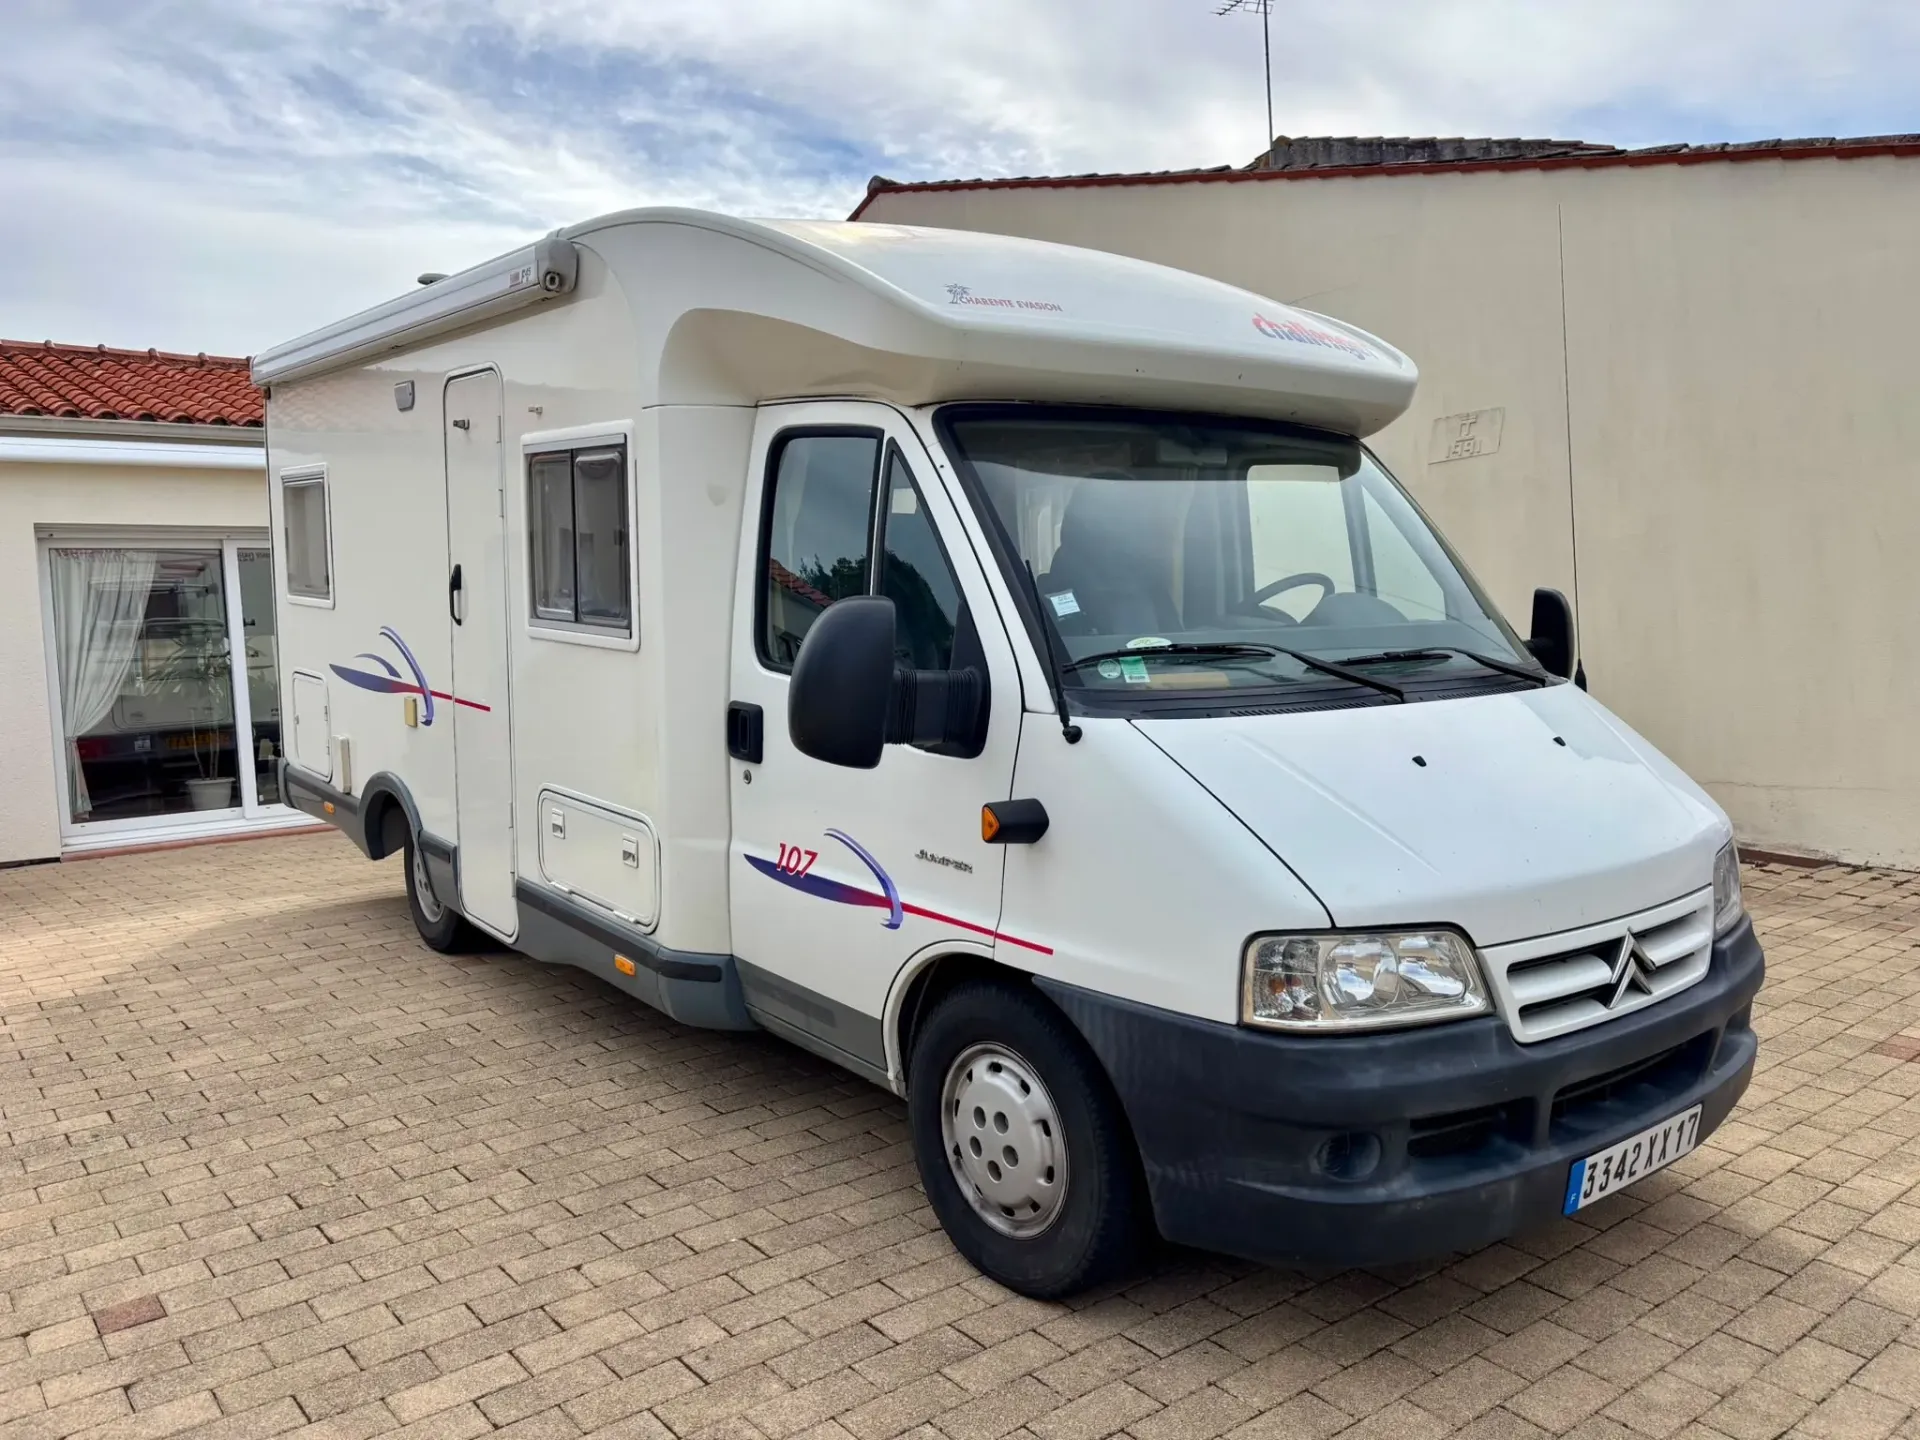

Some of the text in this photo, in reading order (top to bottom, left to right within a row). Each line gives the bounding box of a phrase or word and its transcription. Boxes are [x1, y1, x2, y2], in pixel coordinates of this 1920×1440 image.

[959, 296, 1063, 312] CHARENTE EVASION
[776, 842, 819, 878] 107
